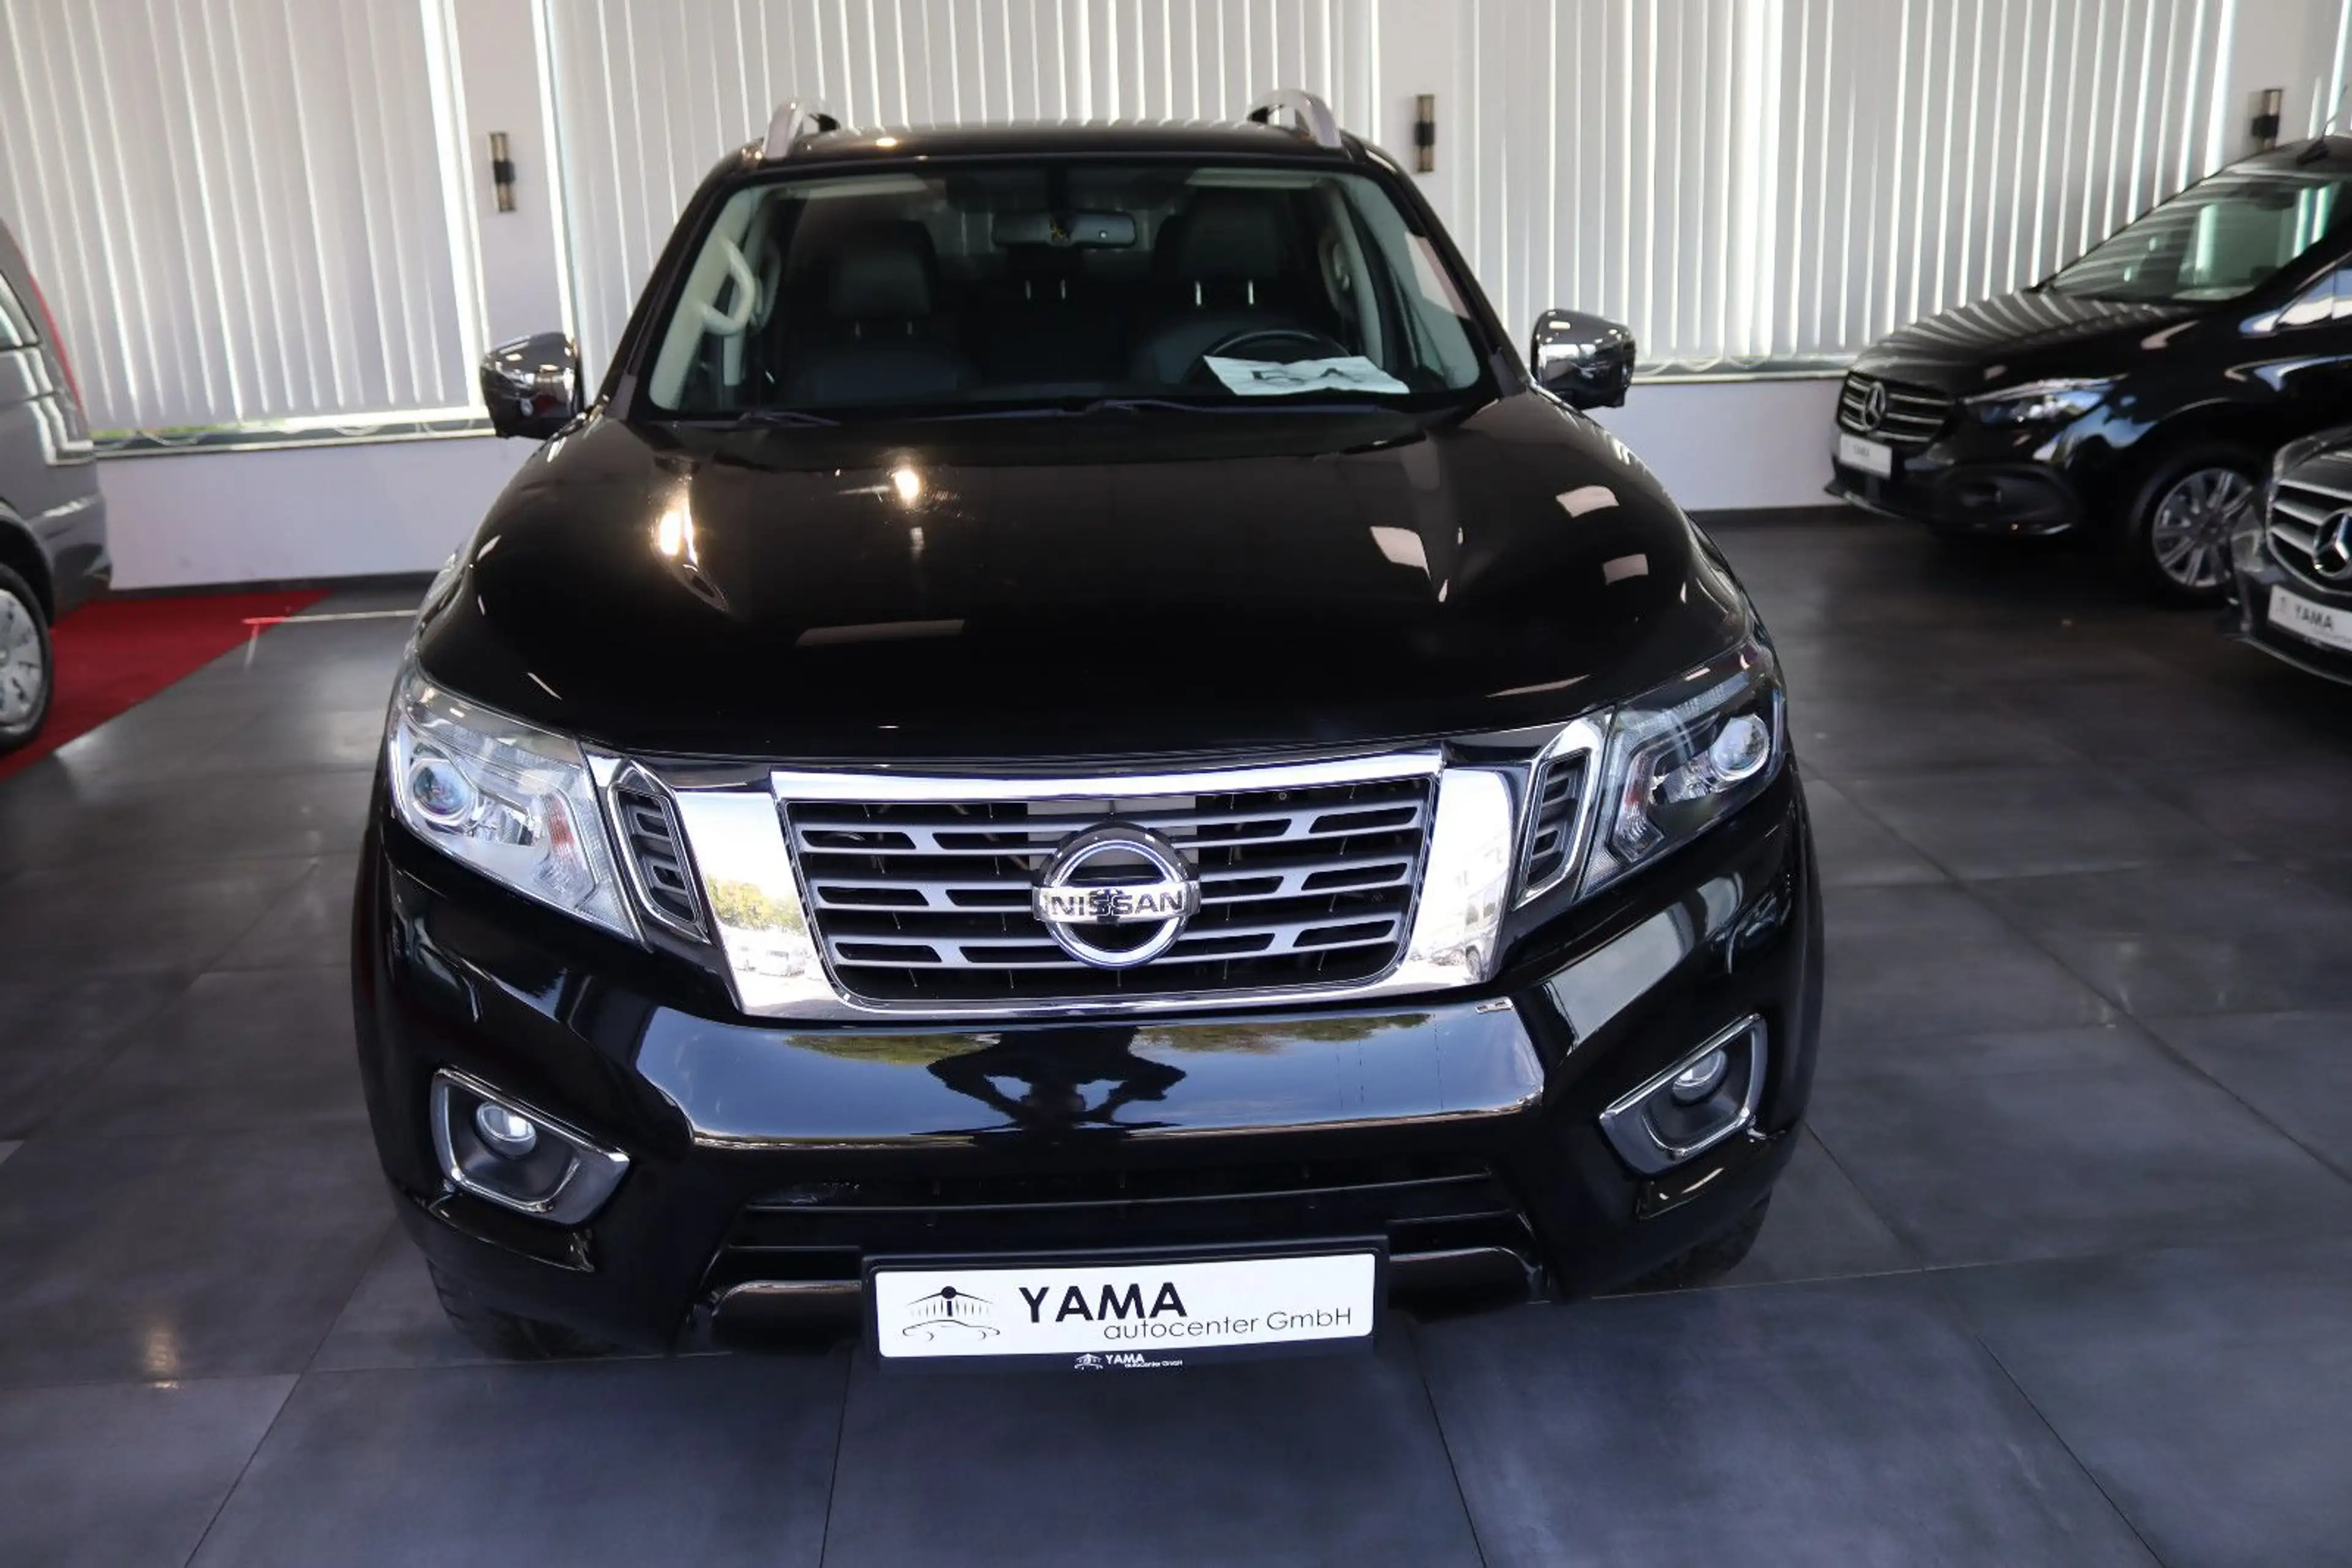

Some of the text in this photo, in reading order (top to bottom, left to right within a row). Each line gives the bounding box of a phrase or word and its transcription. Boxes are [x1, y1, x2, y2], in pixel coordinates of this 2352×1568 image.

[1050, 890, 1183, 916] NISSAN
[1018, 1282, 1188, 1323] YAMA
[1103, 1307, 1351, 1340] autocenter GmbH
[1105, 1353, 1145, 1365] YAMA
